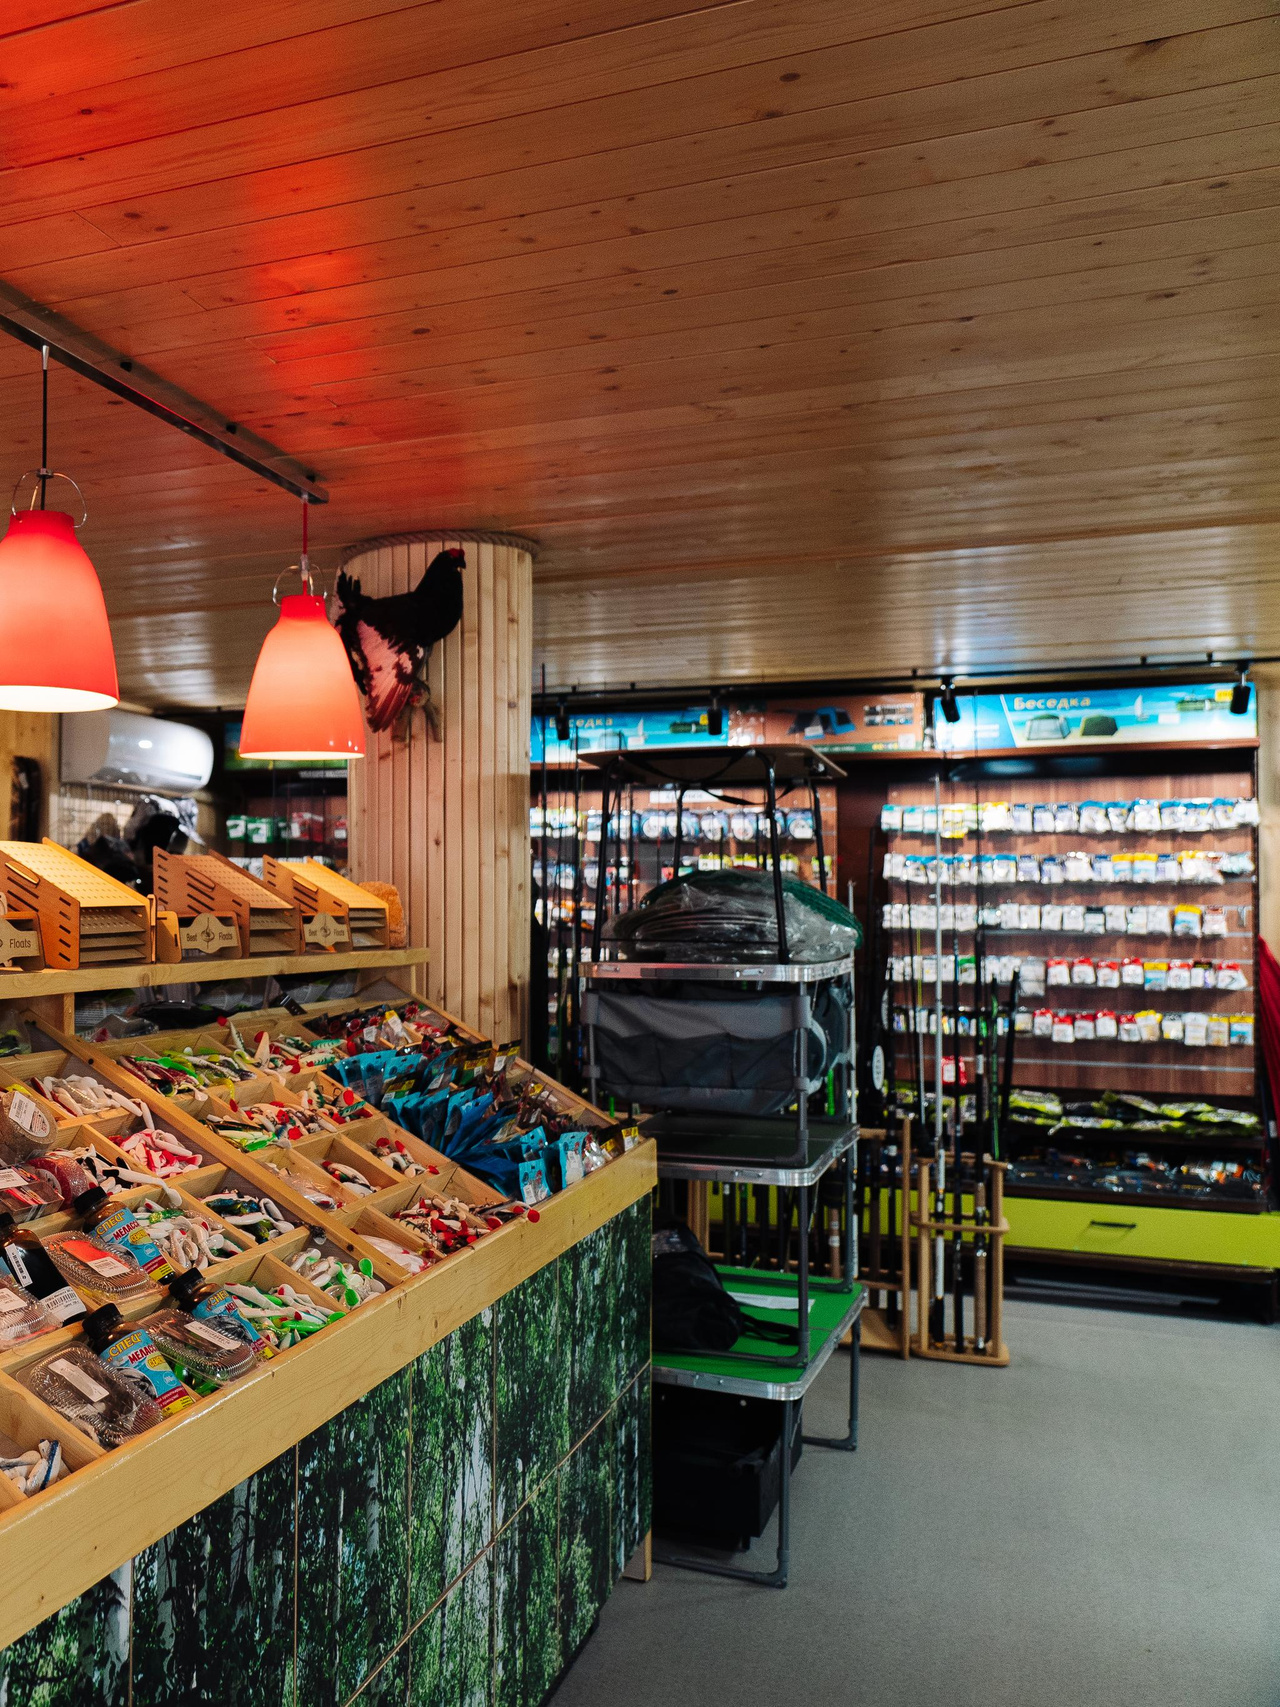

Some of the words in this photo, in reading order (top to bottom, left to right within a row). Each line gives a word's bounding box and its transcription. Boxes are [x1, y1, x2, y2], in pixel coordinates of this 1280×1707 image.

[1012, 696, 1092, 712] Беседка
[185, 932, 199, 943] Best
[217, 931, 234, 942] Floats
[307, 928, 319, 938] Best
[8, 937, 32, 950] Floats
